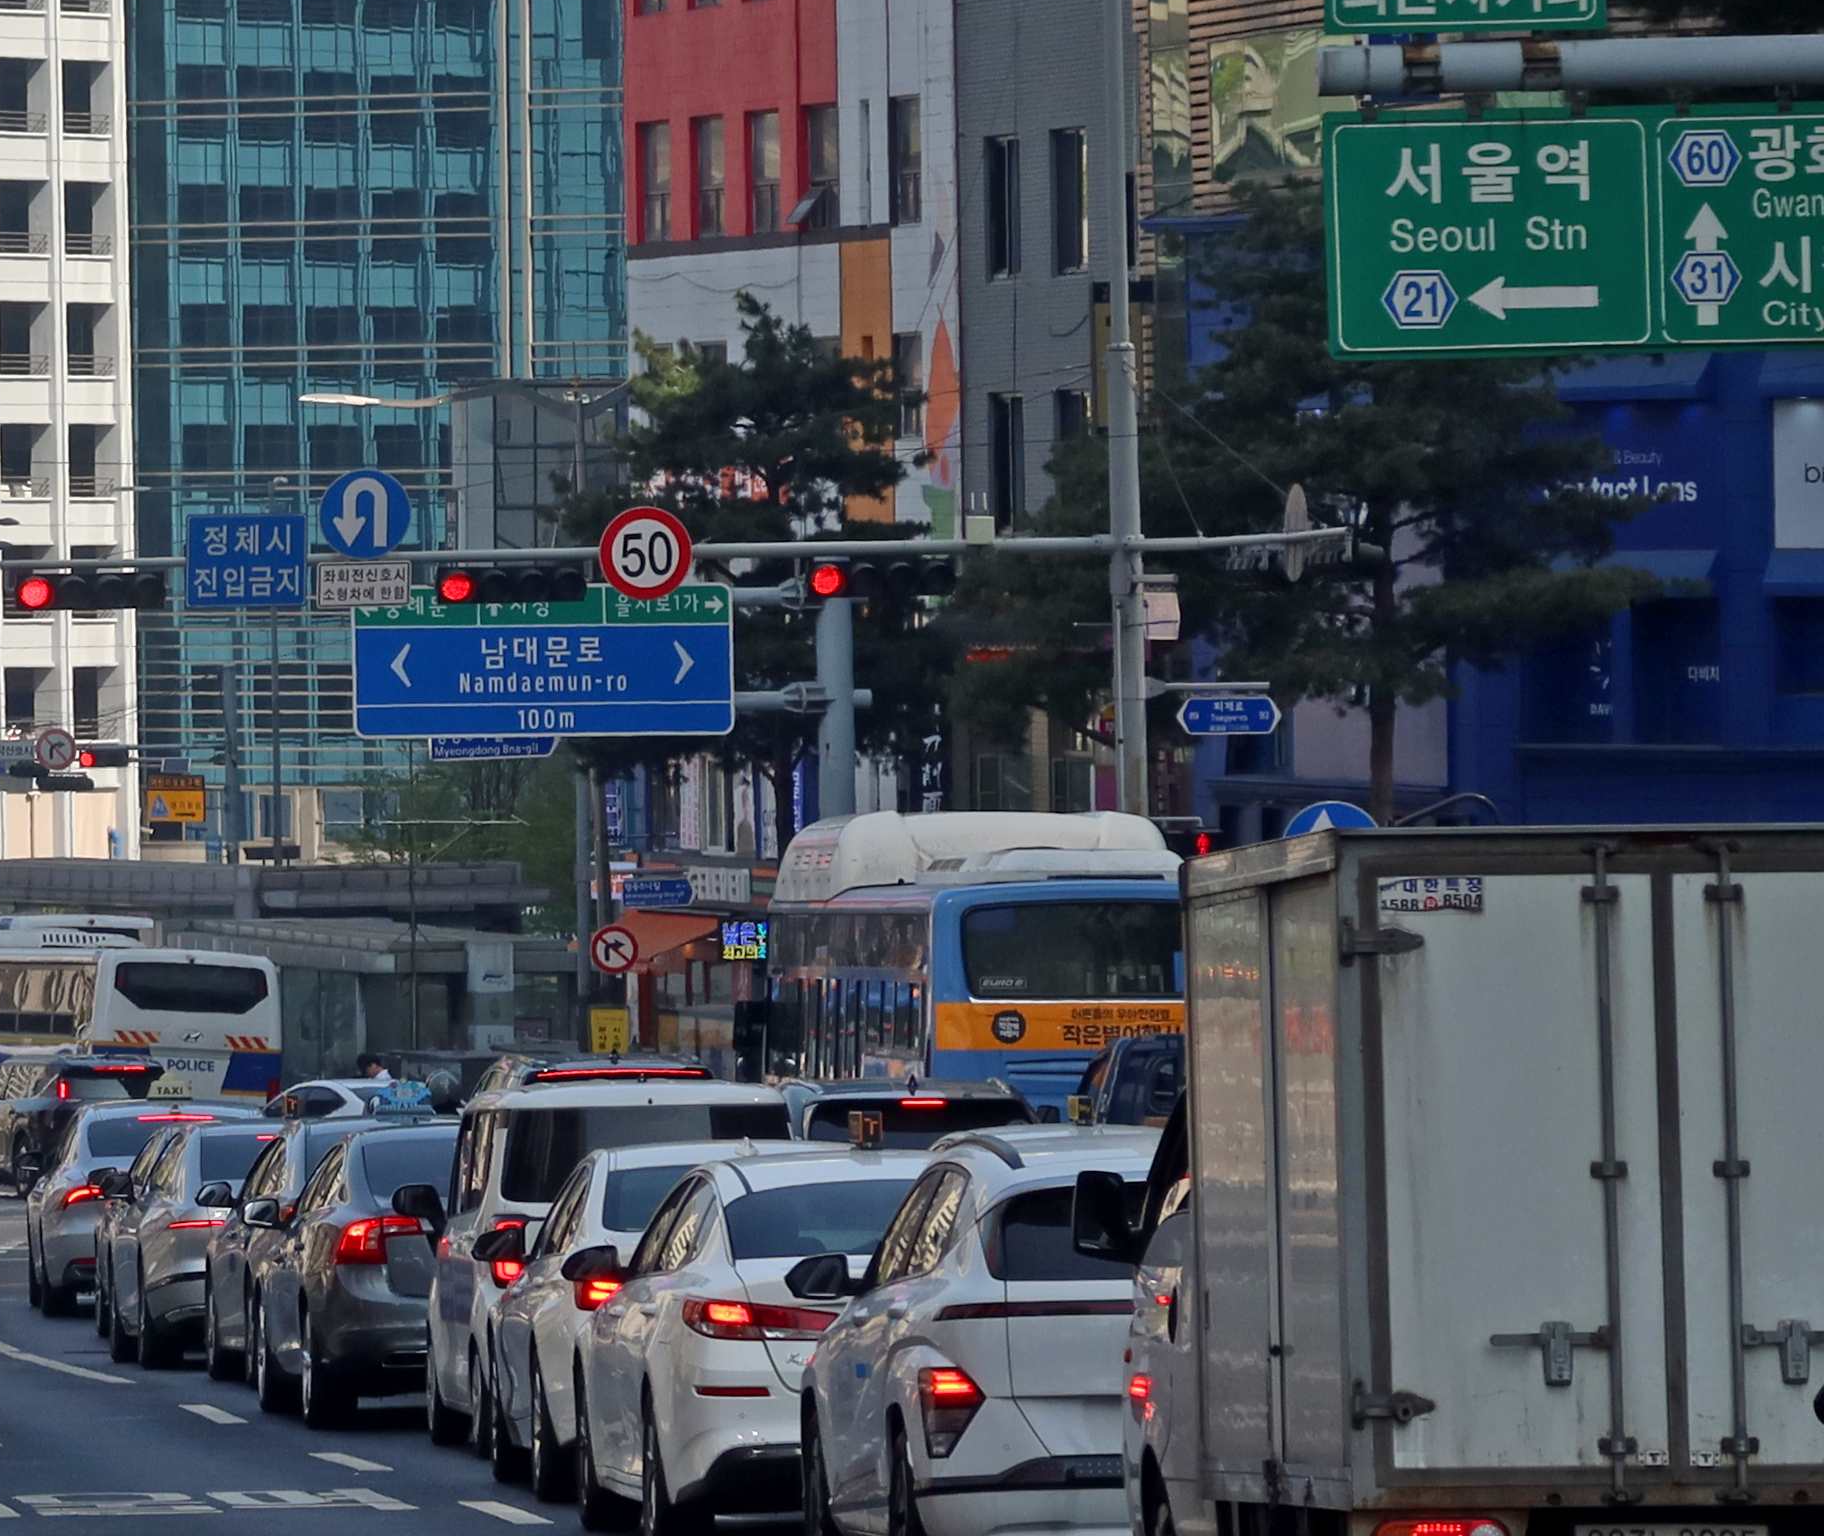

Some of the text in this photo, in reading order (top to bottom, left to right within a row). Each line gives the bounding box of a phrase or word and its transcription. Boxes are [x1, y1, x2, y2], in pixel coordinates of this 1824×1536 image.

[1686, 139, 1725, 176] 60
[1384, 139, 1591, 205] 서울역
[1389, 215, 1587, 253] Seoul Stn
[1689, 260, 1723, 295] 31
[1403, 280, 1439, 319] 21
[203, 524, 292, 557] 정체시
[620, 530, 673, 579] 50
[193, 565, 300, 599] 진입금지
[322, 567, 407, 584] 좌회전신호시
[322, 586, 405, 602] 소형차에 한함
[479, 636, 604, 670] 남대문로
[459, 671, 628, 694] Namdaemun-ro
[1687, 666, 1720, 682] 다비치
[517, 708, 575, 730] 100m
[433, 743, 539, 759] Myeongdong 8na-gil
[1443, 893, 1483, 911] 8504
[166, 1058, 216, 1073] POLICE
[155, 1084, 184, 1096] TAXI
